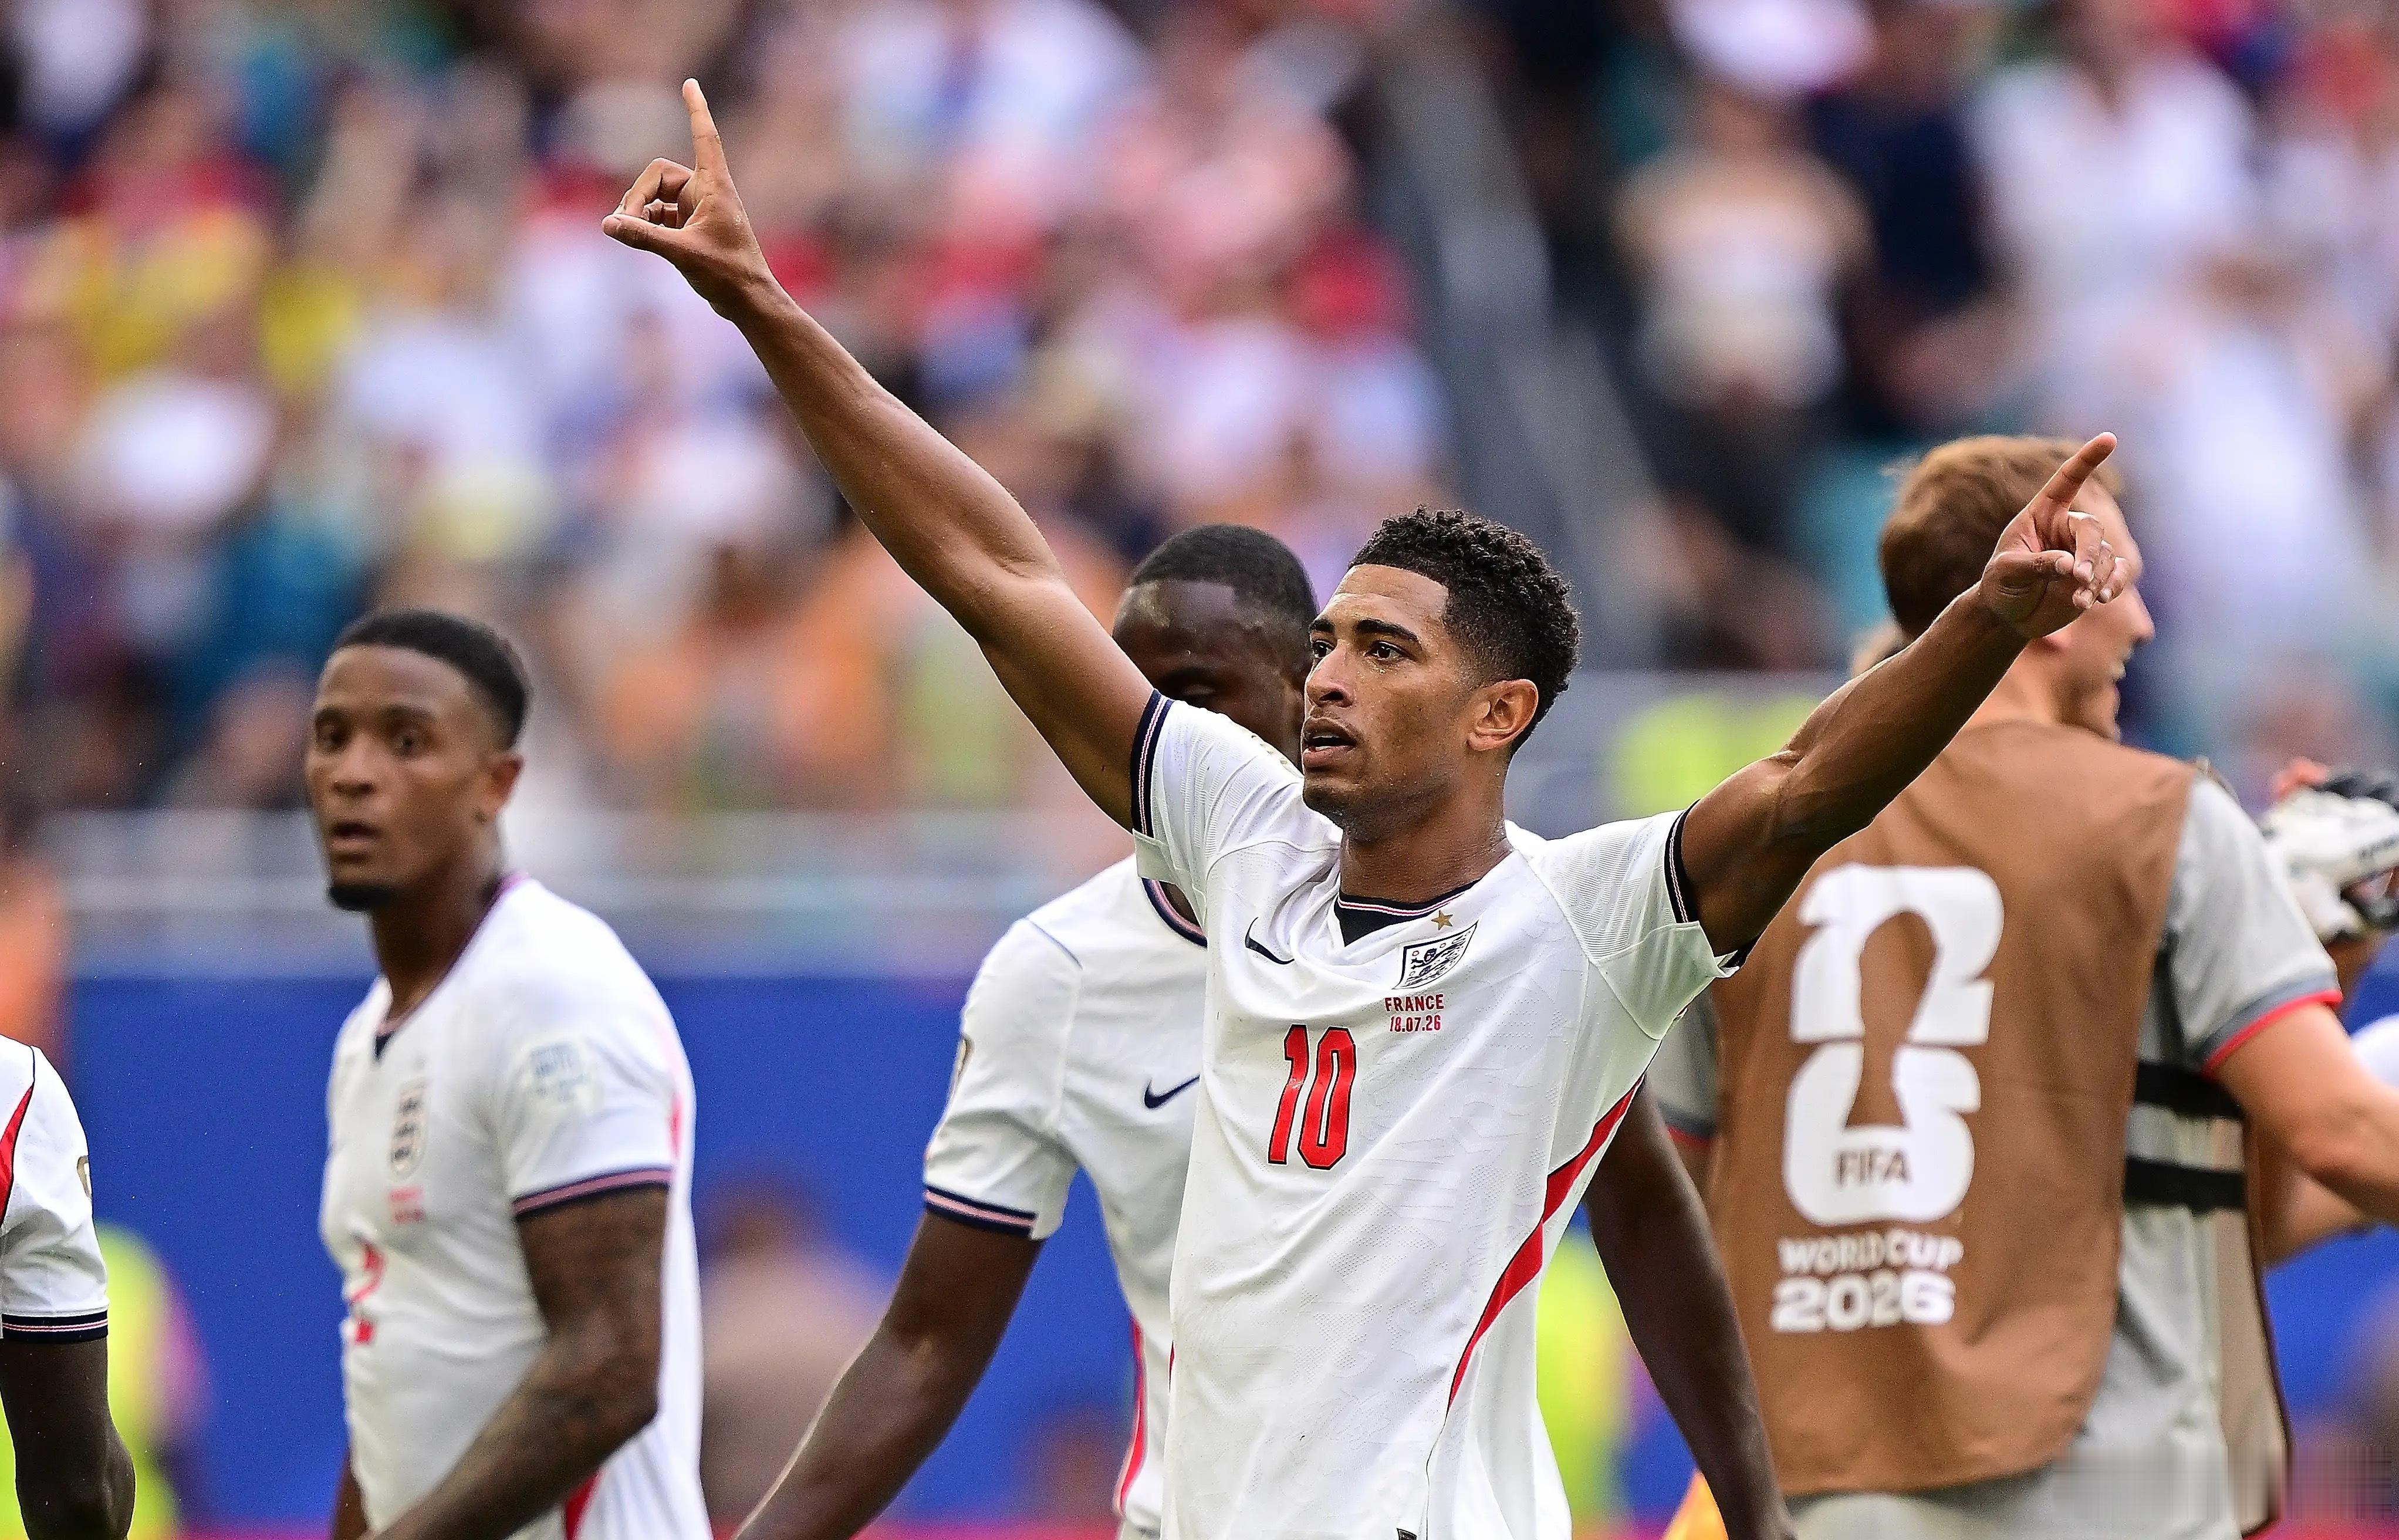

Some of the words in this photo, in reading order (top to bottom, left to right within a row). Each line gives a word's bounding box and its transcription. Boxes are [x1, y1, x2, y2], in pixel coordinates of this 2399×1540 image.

[1384, 994, 1444, 1012] FRANCE
[1390, 1014, 1441, 1032] 18.07.26
[1268, 1024, 1357, 1170] 10
[1834, 1148, 1912, 1186] FIFA
[1778, 1234, 1885, 1272] WORLD
[1885, 1231, 1964, 1271] CUP
[1771, 1270, 1957, 1332] 2026
